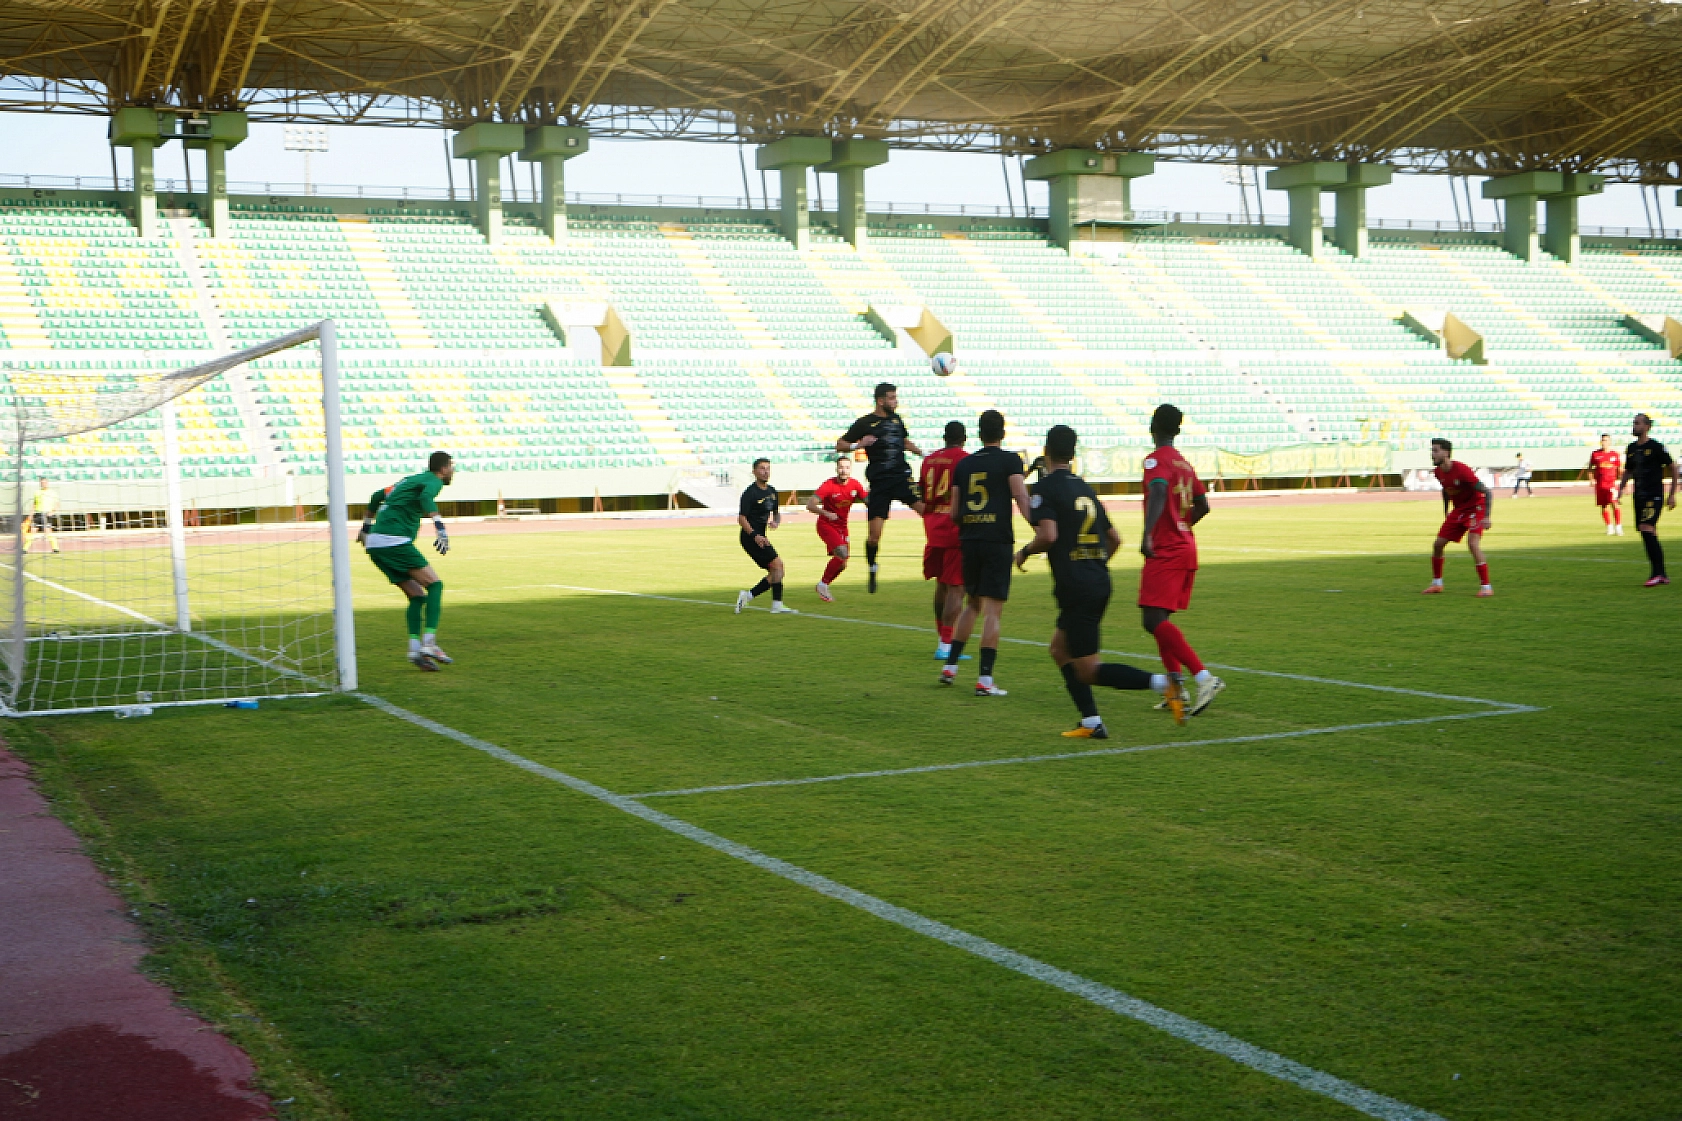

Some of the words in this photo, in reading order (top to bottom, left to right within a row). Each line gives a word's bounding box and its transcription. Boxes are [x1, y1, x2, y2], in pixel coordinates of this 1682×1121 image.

[33, 189, 42, 198] C
[269, 196, 279, 205] C
[925, 466, 951, 502] 14
[966, 471, 989, 511] 5
[1074, 496, 1100, 544] 2
